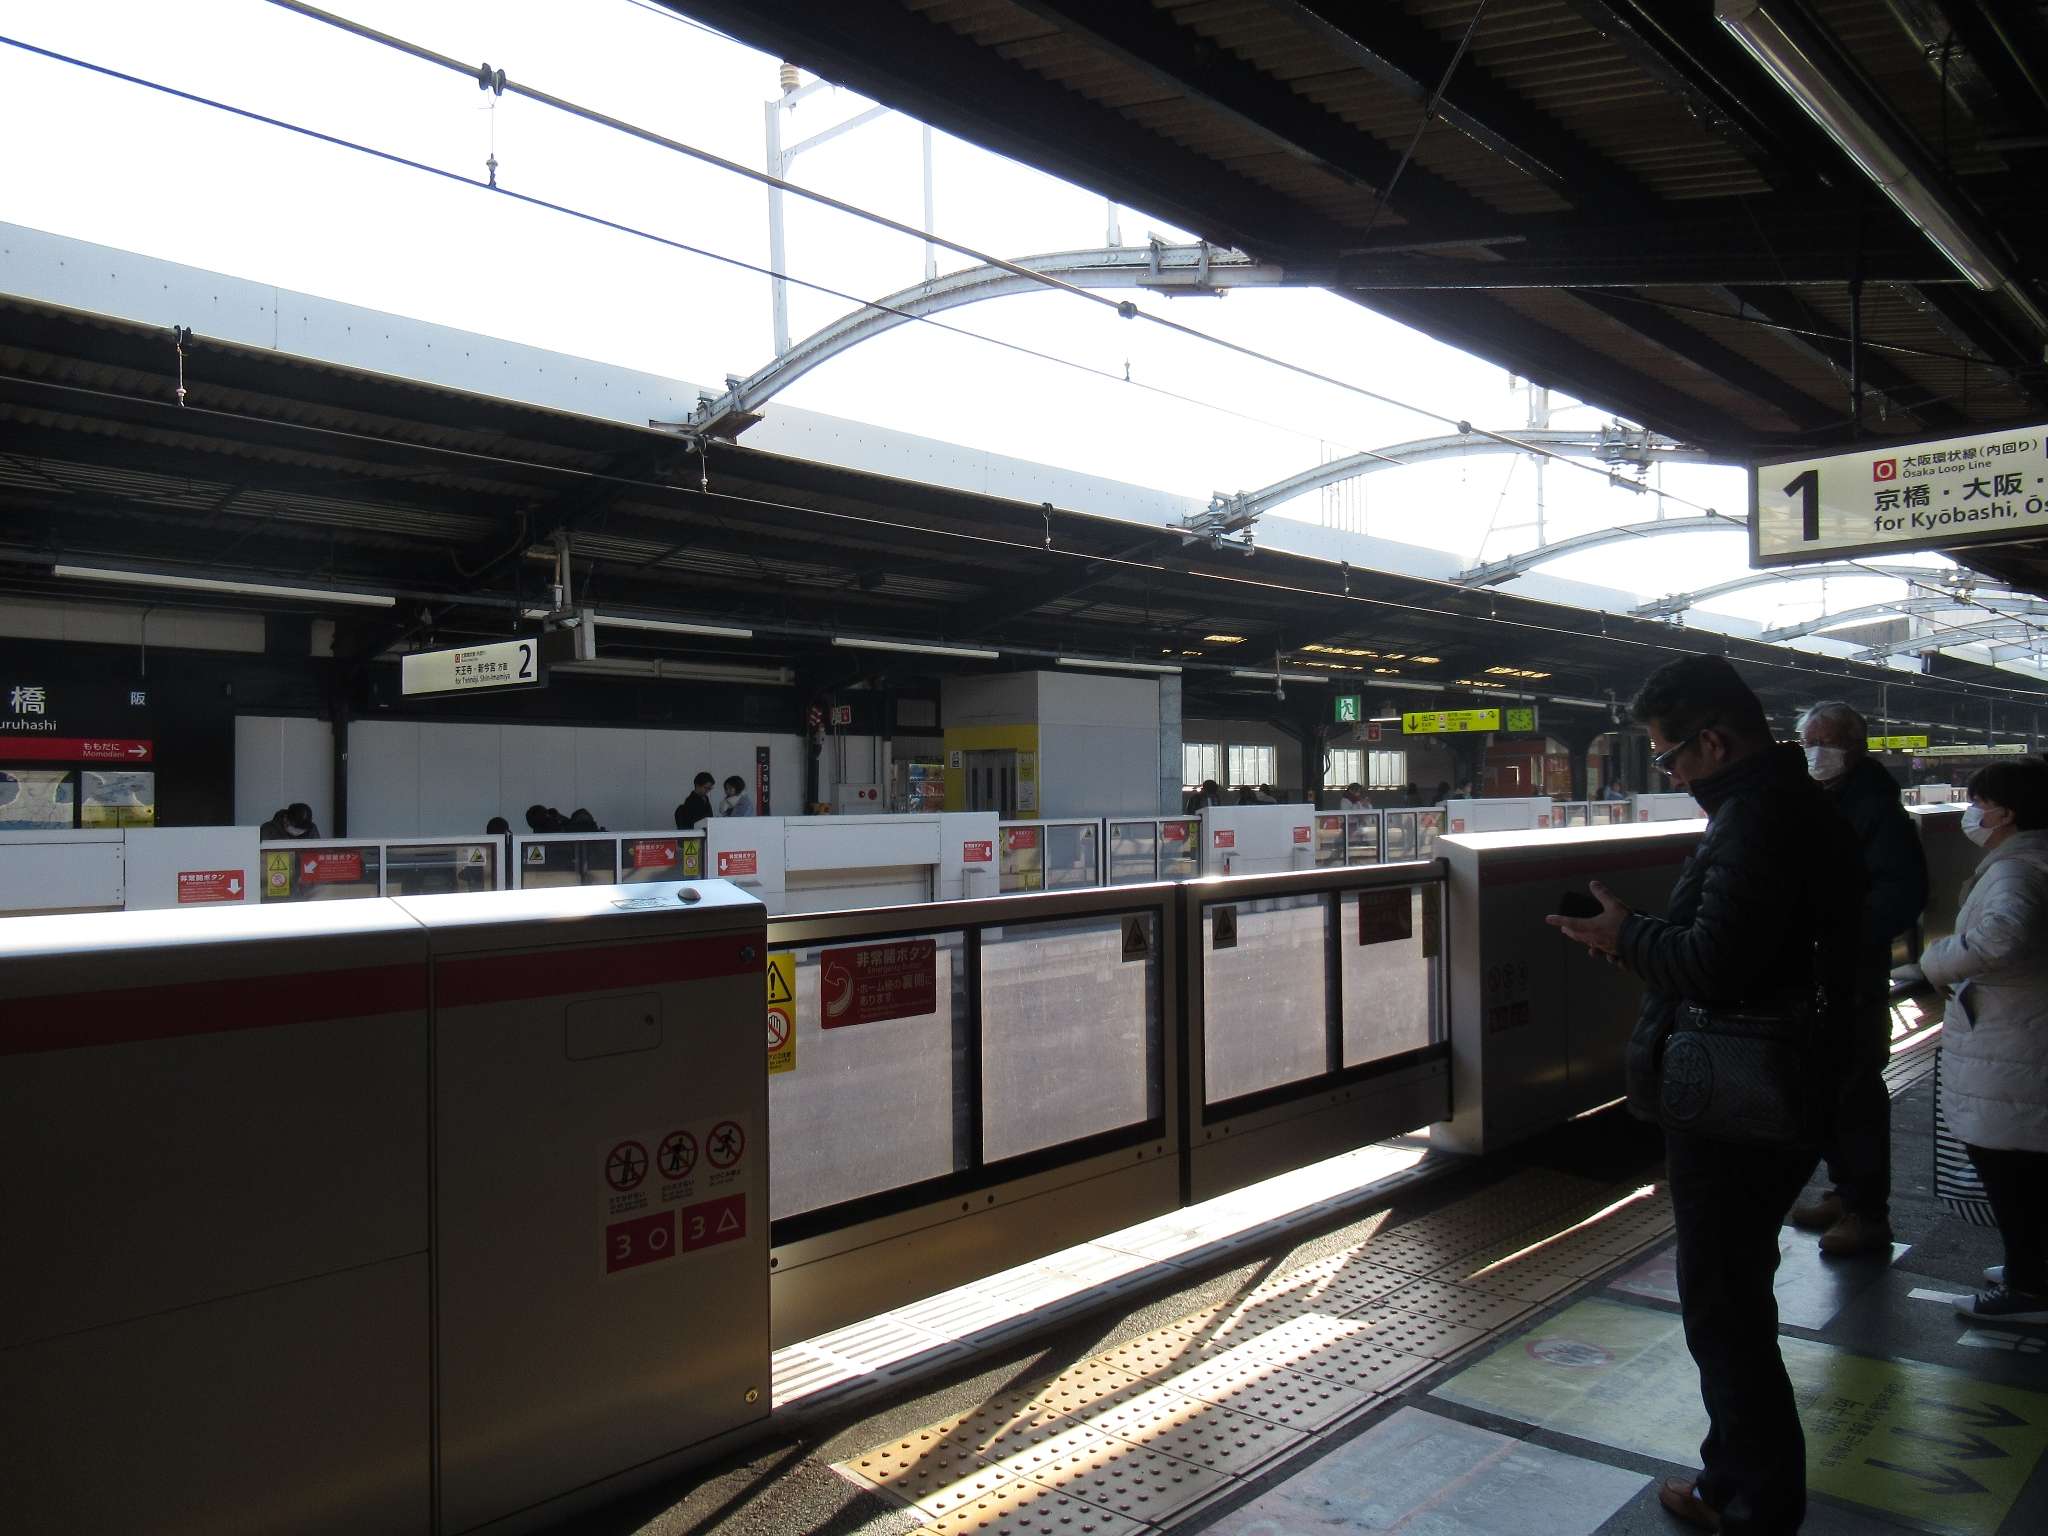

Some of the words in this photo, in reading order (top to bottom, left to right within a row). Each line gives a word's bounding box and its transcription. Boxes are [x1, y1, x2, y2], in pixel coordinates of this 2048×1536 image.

[1903, 439, 2038, 468] 大阪環状線(内回り)
[1938, 462, 1966, 475] Loop
[1968, 459, 1992, 471] Line
[1783, 469, 1819, 541] 1
[1874, 515, 1906, 532] for
[1911, 499, 2018, 530] Kyōbashi,
[519, 644, 532, 679] 2
[11, 685, 48, 715] 橋
[130, 691, 146, 705] 阪
[82, 750, 125, 760] Momodani
[83, 742, 121, 752] ももだに
[690, 1215, 705, 1240] 3
[615, 1232, 632, 1260] 3
